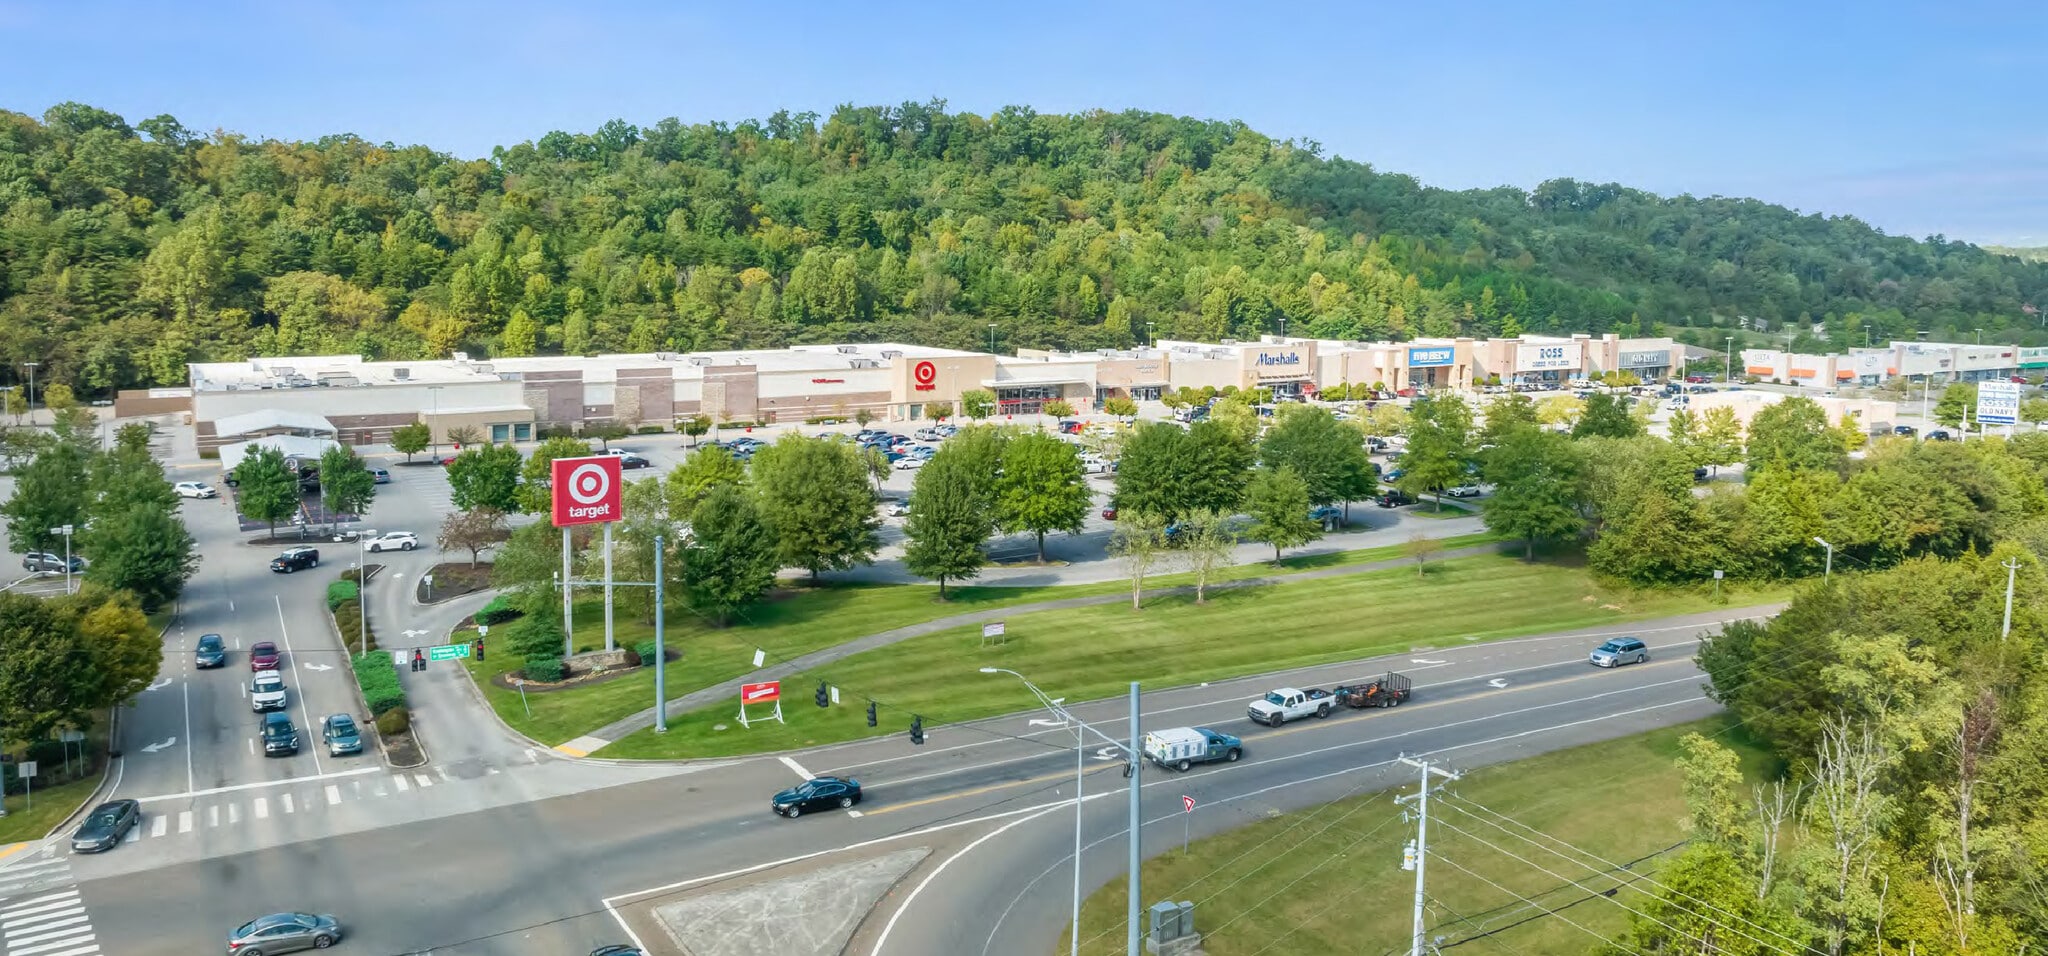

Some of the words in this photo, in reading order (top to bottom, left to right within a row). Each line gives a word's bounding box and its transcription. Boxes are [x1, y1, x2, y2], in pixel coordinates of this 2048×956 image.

[1255, 352, 1300, 366] Marshalls
[1540, 348, 1563, 358] ROSS
[569, 503, 610, 518] target
